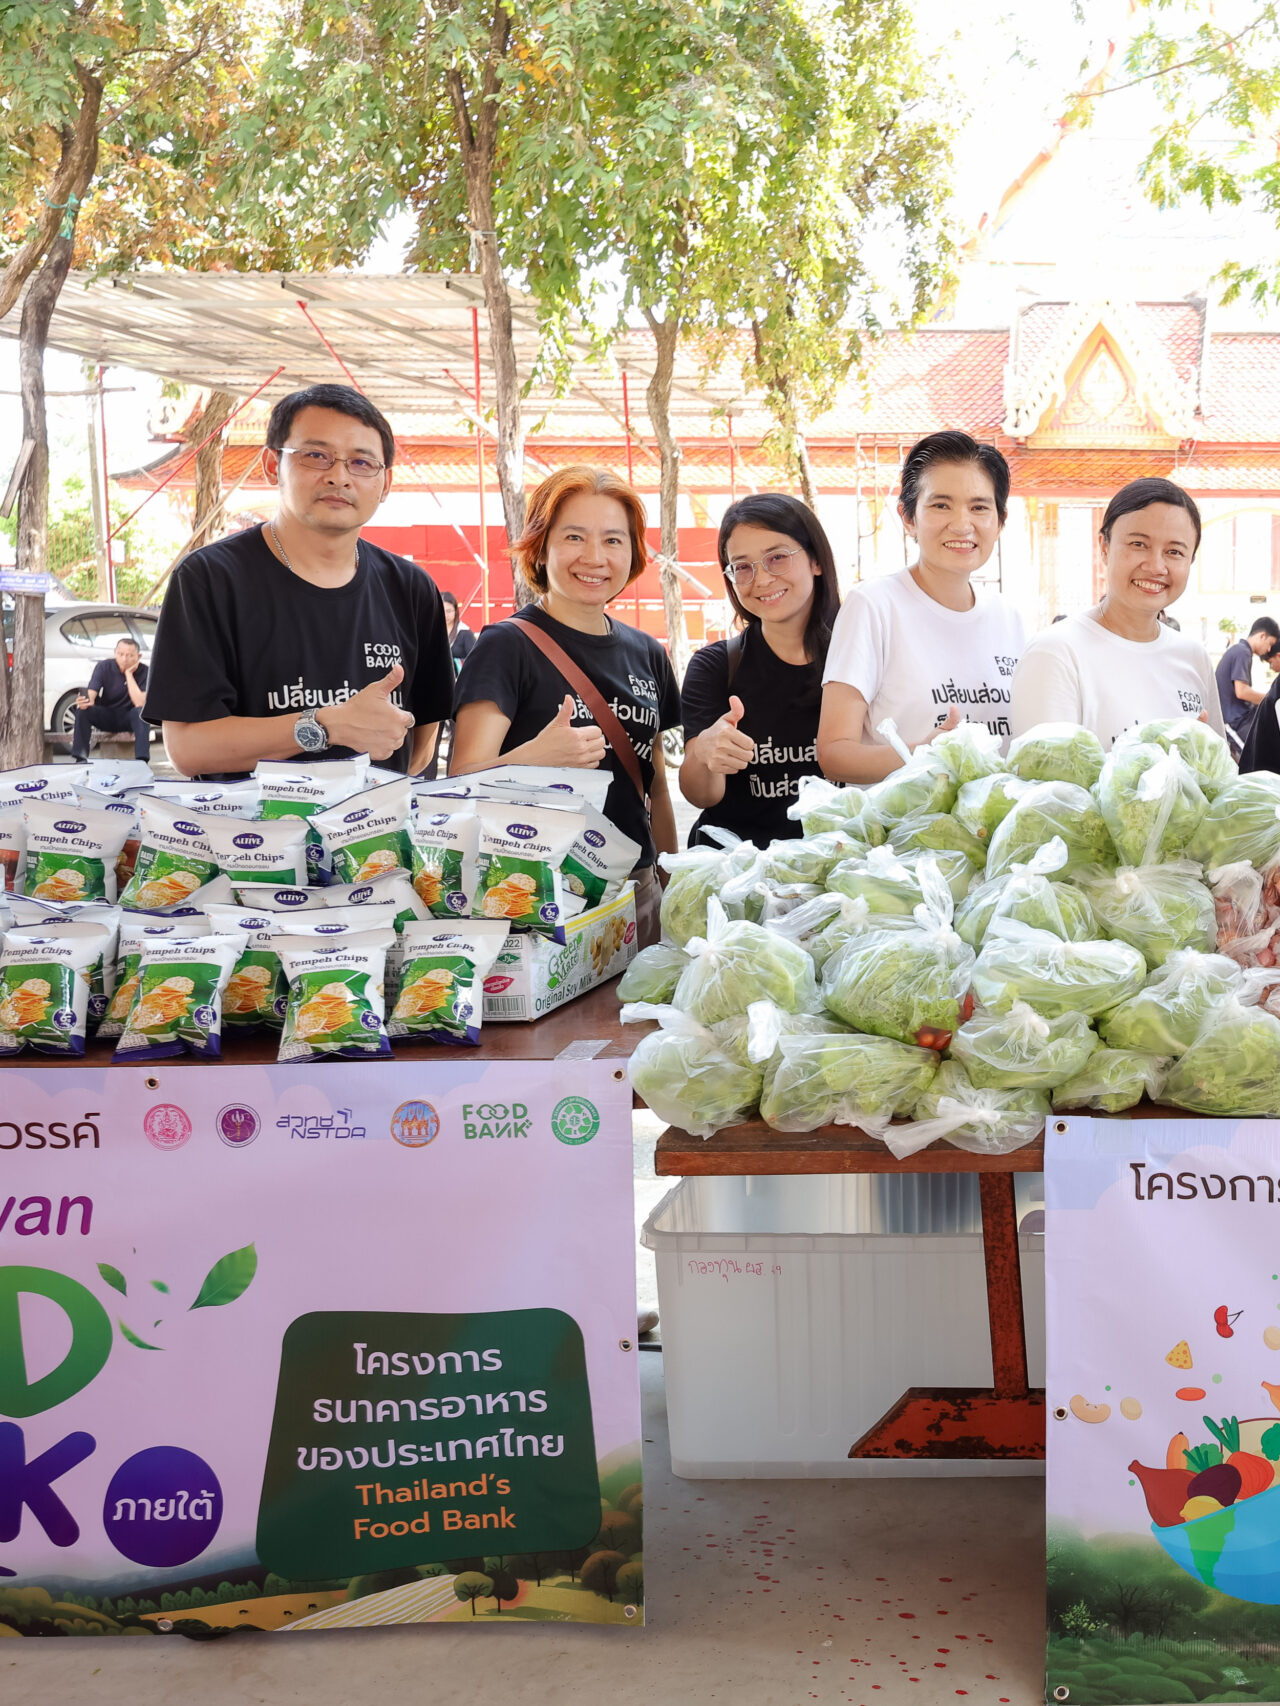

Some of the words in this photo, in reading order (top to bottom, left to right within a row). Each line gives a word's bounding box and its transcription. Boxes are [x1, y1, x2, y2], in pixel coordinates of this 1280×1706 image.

[364, 643, 401, 655] FOOD
[296, 786, 326, 797] Chips
[212, 804, 243, 812] Chips
[366, 814, 398, 829] Chips
[148, 830, 190, 847] Tempeh
[235, 836, 263, 846] ALTIVE
[523, 842, 553, 854] Chips
[254, 854, 285, 864] Chips
[277, 894, 307, 903] ALTIVE
[41, 947, 73, 957] Chips
[184, 947, 217, 957] Chips
[289, 956, 332, 969] Tempeh
[335, 955, 369, 964] Chips
[536, 988, 565, 1012] Original
[566, 982, 579, 998] Soy
[579, 970, 593, 989] Milk
[463, 1103, 528, 1120] FOOD
[291, 1127, 366, 1139] NSTDA
[464, 1122, 528, 1140] BANK
[353, 1343, 503, 1376] โครงการ
[313, 1388, 548, 1424] ธนาคารอาหาร
[297, 1428, 565, 1472] ของประเทศไทย
[355, 1473, 511, 1507] Thailand's
[113, 1489, 215, 1521] ภายใต้
[354, 1511, 430, 1540] Food
[443, 1507, 516, 1533] Bank
